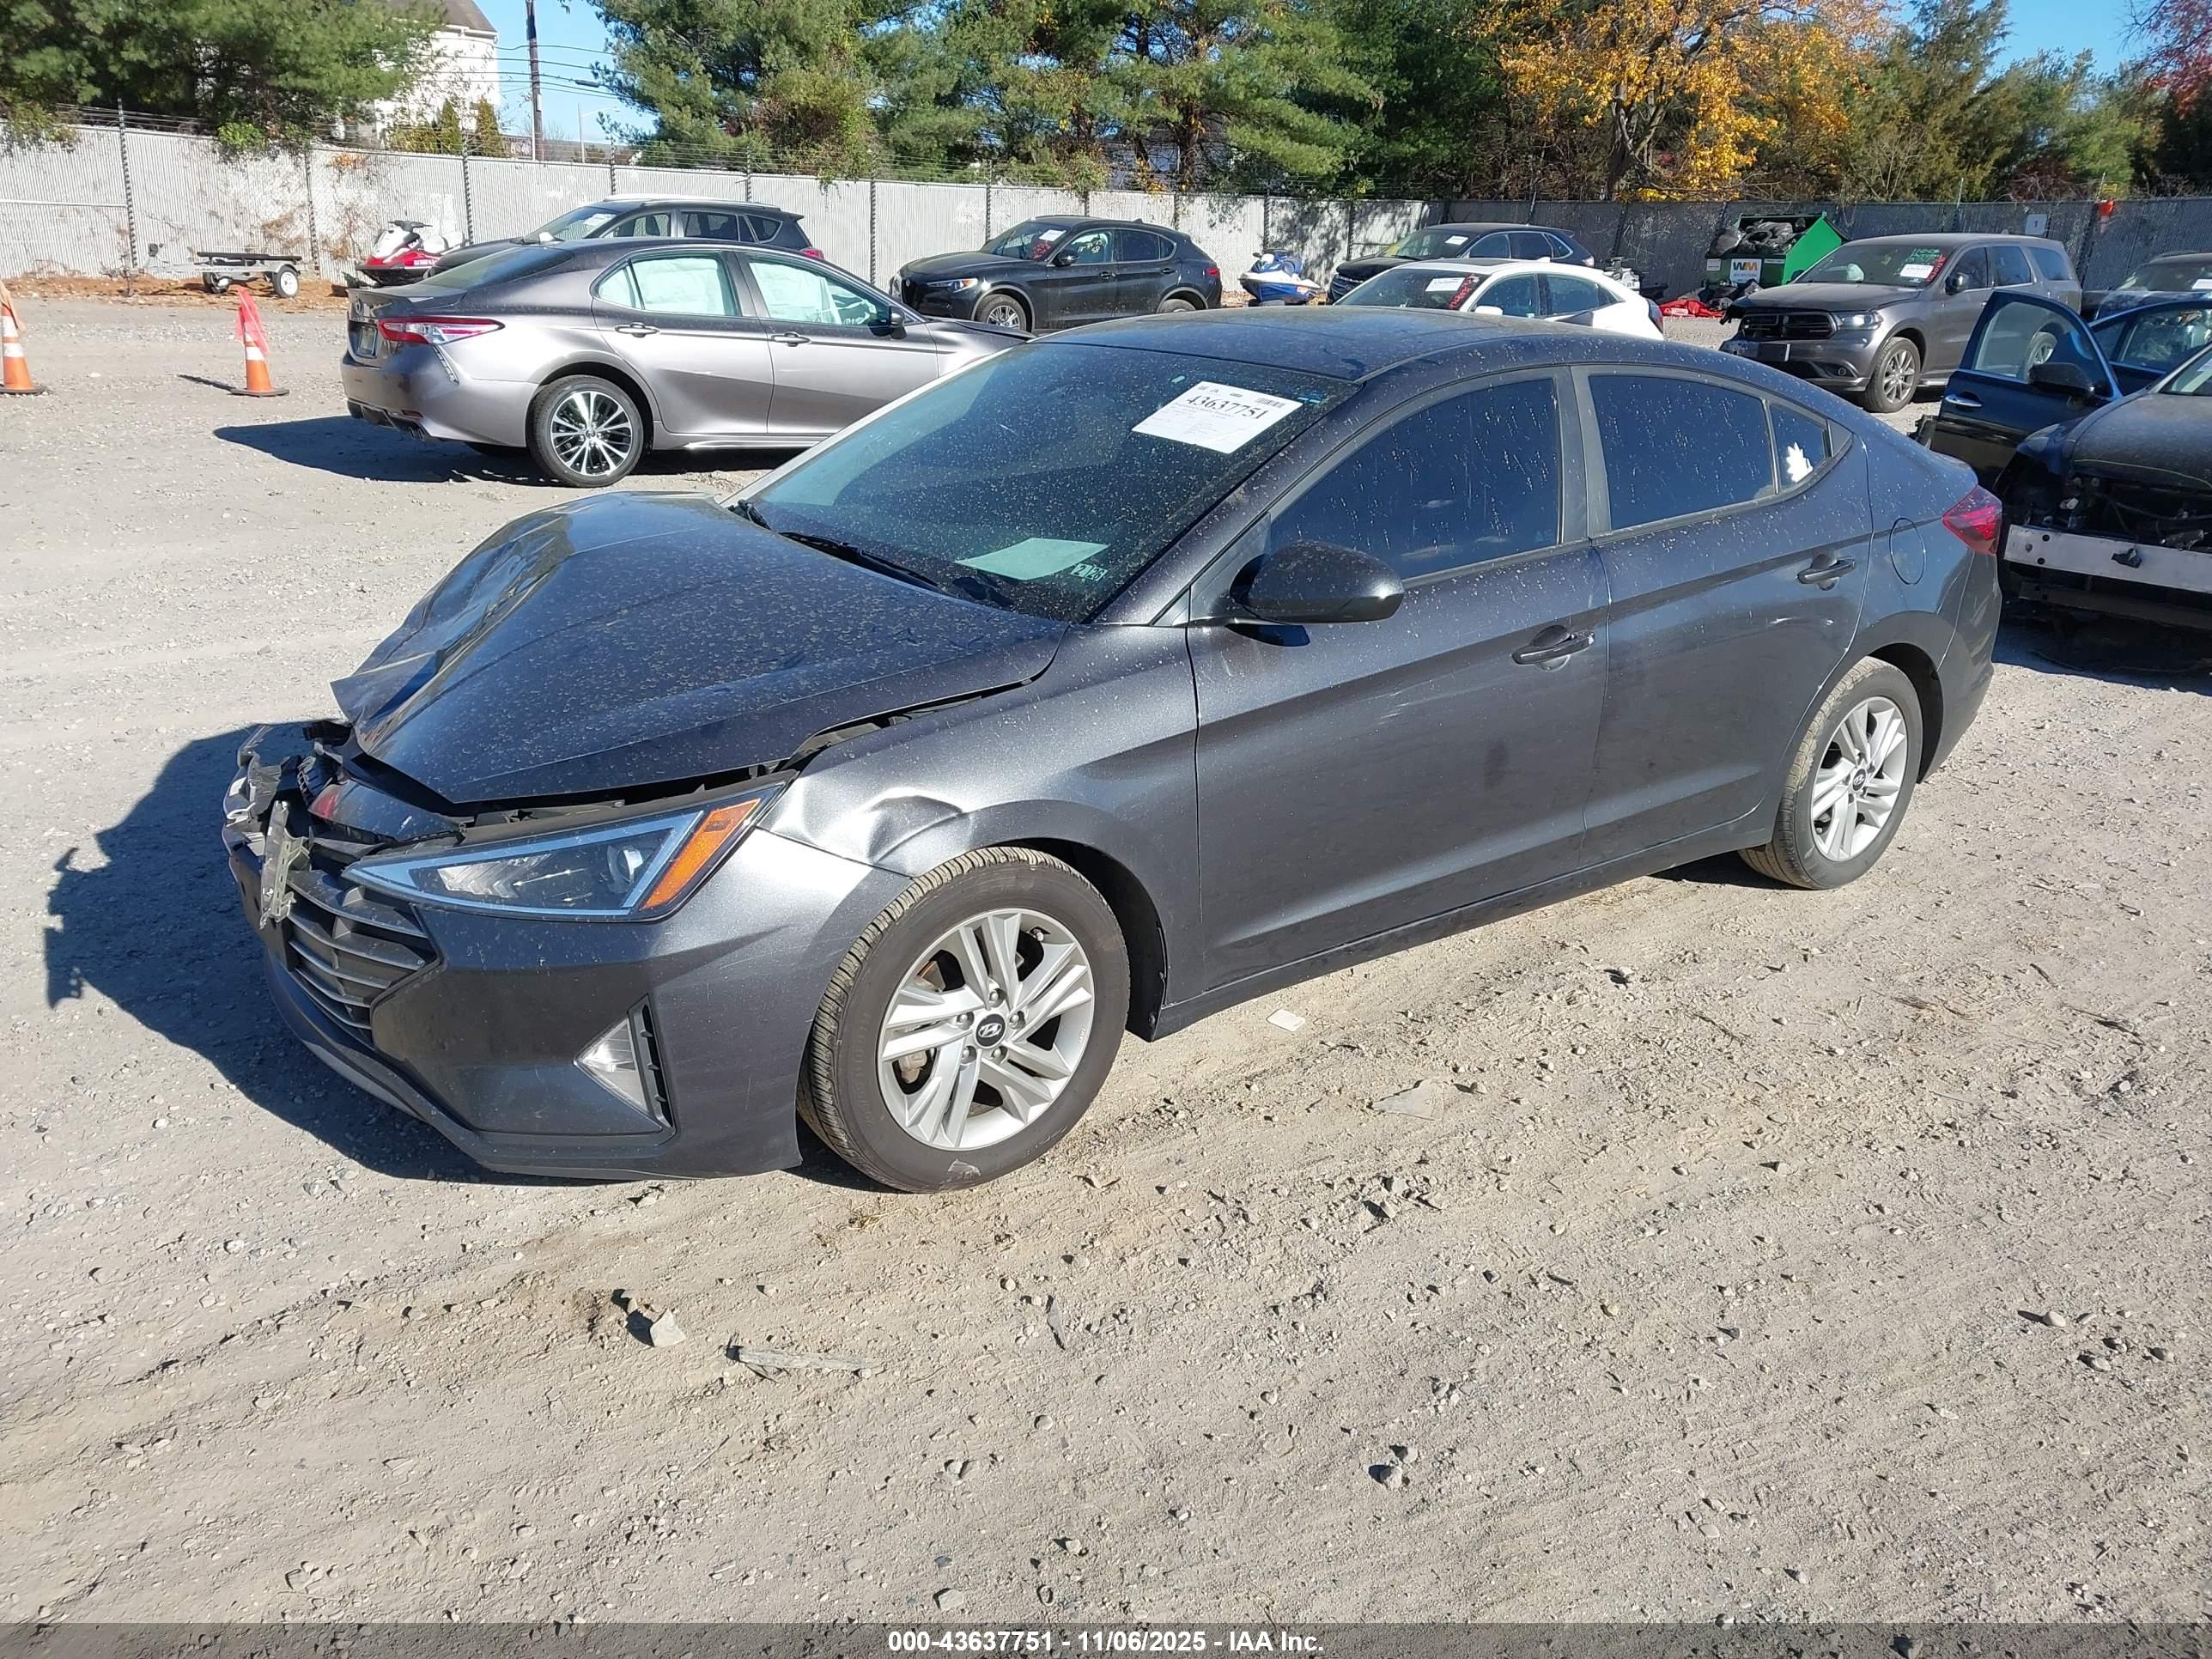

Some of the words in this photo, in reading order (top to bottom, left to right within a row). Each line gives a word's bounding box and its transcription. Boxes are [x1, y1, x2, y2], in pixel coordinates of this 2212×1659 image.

[1733, 261, 1759, 271] WM
[1187, 395, 1269, 419] 43637751
[1073, 564, 1087, 575] 2
